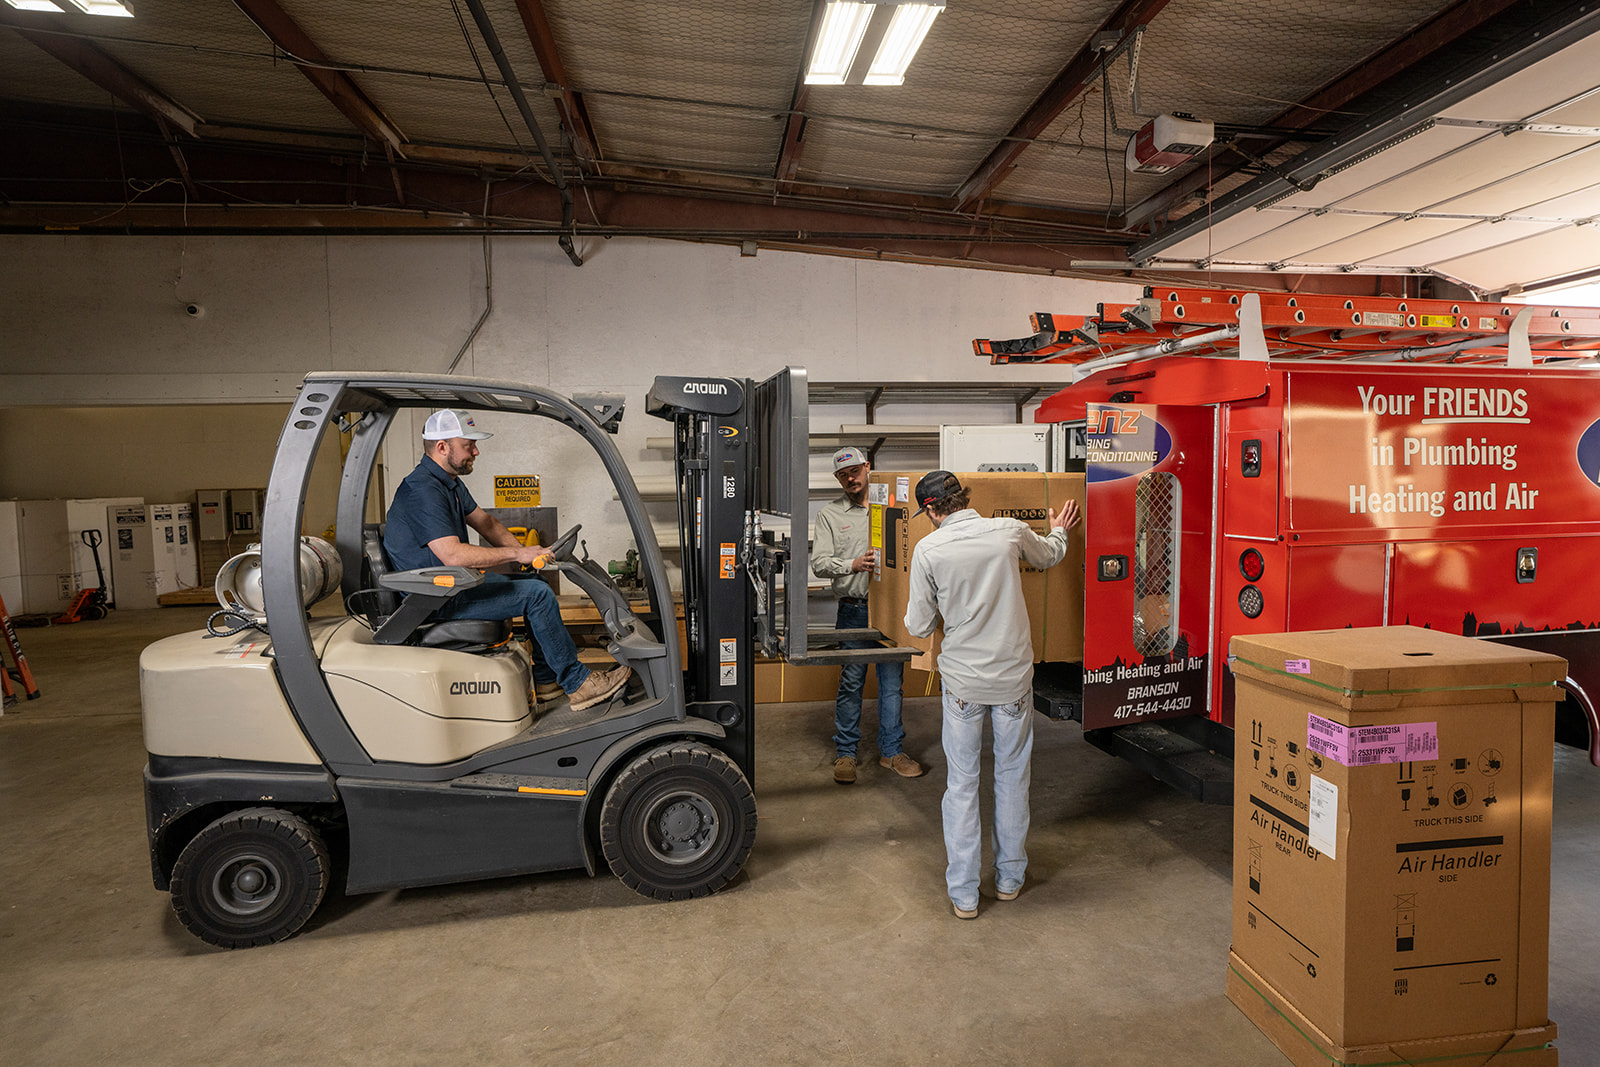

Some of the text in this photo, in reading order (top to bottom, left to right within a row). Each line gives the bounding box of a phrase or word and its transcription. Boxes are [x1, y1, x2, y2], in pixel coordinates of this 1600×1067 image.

[684, 382, 728, 395] CROWN
[1358, 385, 1528, 418] Your FRIENDS
[1371, 436, 1518, 471] in Plumbing
[496, 478, 538, 488] CAUTION
[726, 476, 736, 498] 1280
[1348, 483, 1539, 518] Heating and Air
[1116, 664, 1161, 680] Heating
[1164, 658, 1184, 674] and
[1187, 656, 1204, 670] Air
[450, 680, 502, 695] CROWN
[1127, 681, 1180, 700] BRANSON
[1114, 696, 1192, 720] 417-544-4430
[1260, 780, 1308, 812] TRUCK THIS SIDE
[1414, 814, 1484, 828] TRUCK THIS SIDE
[1250, 809, 1321, 862] Air Handler
[1275, 841, 1292, 856] REAR
[1398, 851, 1502, 874] Air Handler
[1438, 874, 1458, 883] SIDE
